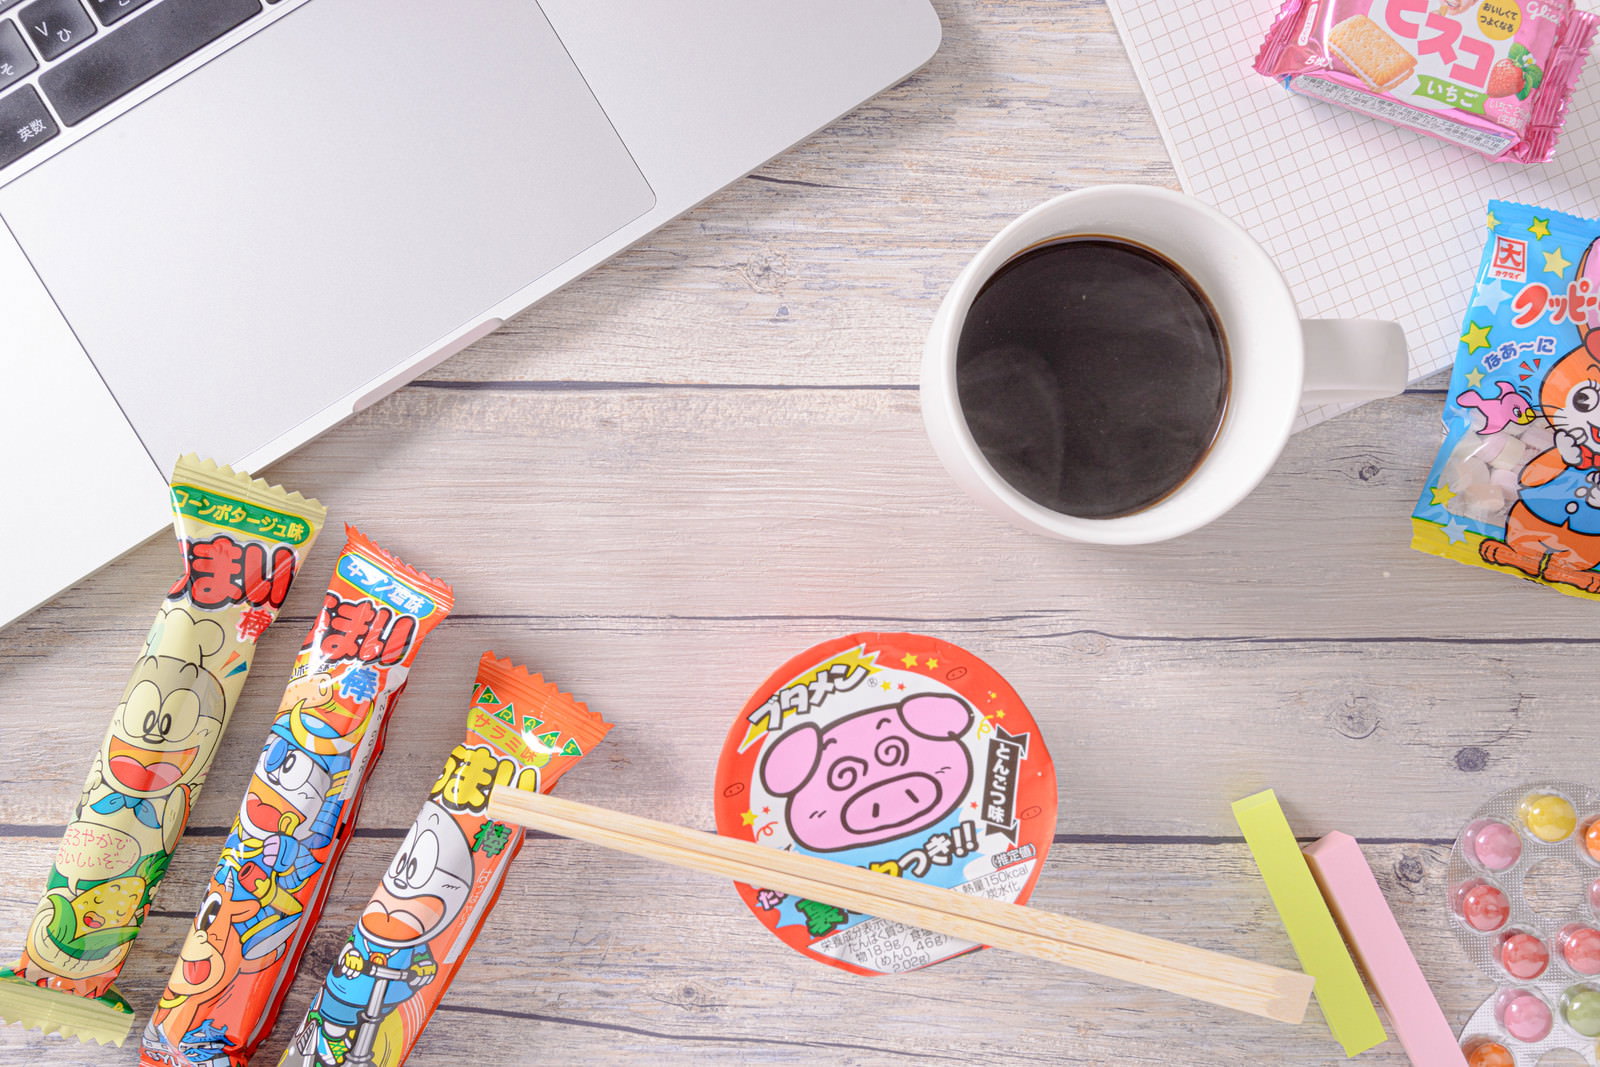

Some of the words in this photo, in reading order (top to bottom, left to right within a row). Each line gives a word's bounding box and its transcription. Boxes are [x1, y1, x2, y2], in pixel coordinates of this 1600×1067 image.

[1482, 2, 1518, 20] おいしくて
[34, 21, 49, 37] V
[1479, 15, 1514, 33] つよくなる
[1427, 80, 1479, 107] いちご
[17, 118, 48, 142] 英数
[1512, 279, 1600, 328] クッピー
[746, 663, 871, 732] ブタメン
[985, 741, 1012, 824] とんこつ味
